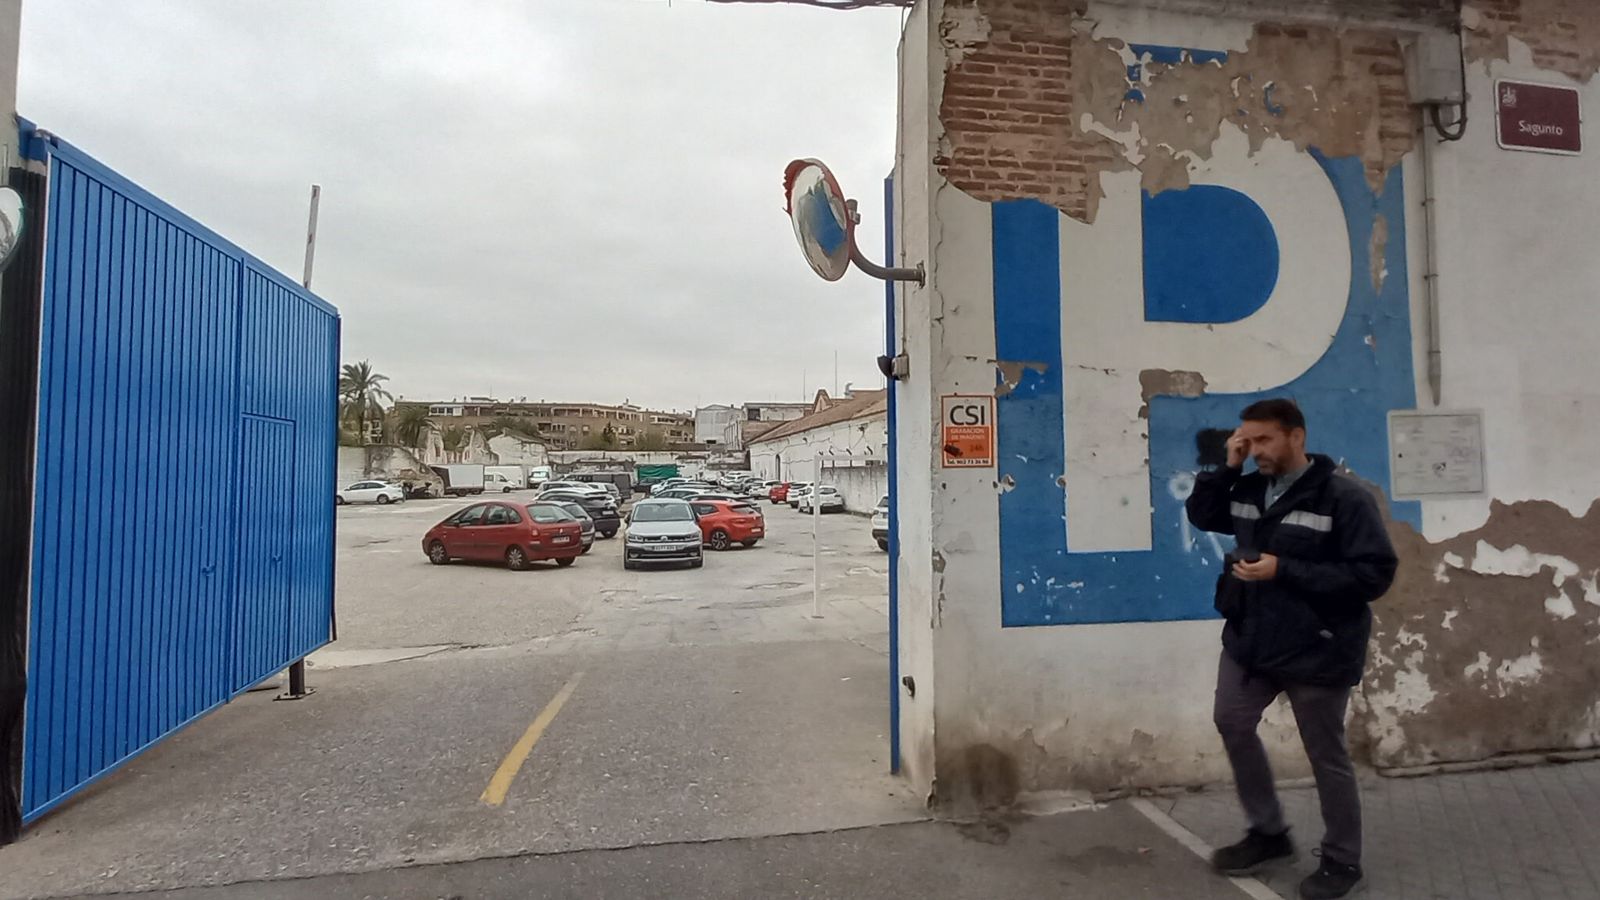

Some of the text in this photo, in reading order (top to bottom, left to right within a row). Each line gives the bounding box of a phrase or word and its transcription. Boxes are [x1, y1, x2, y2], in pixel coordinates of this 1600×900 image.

[1518, 120, 1563, 136] Sagunto
[1059, 118, 1352, 553] P
[949, 405, 985, 426] CSI
